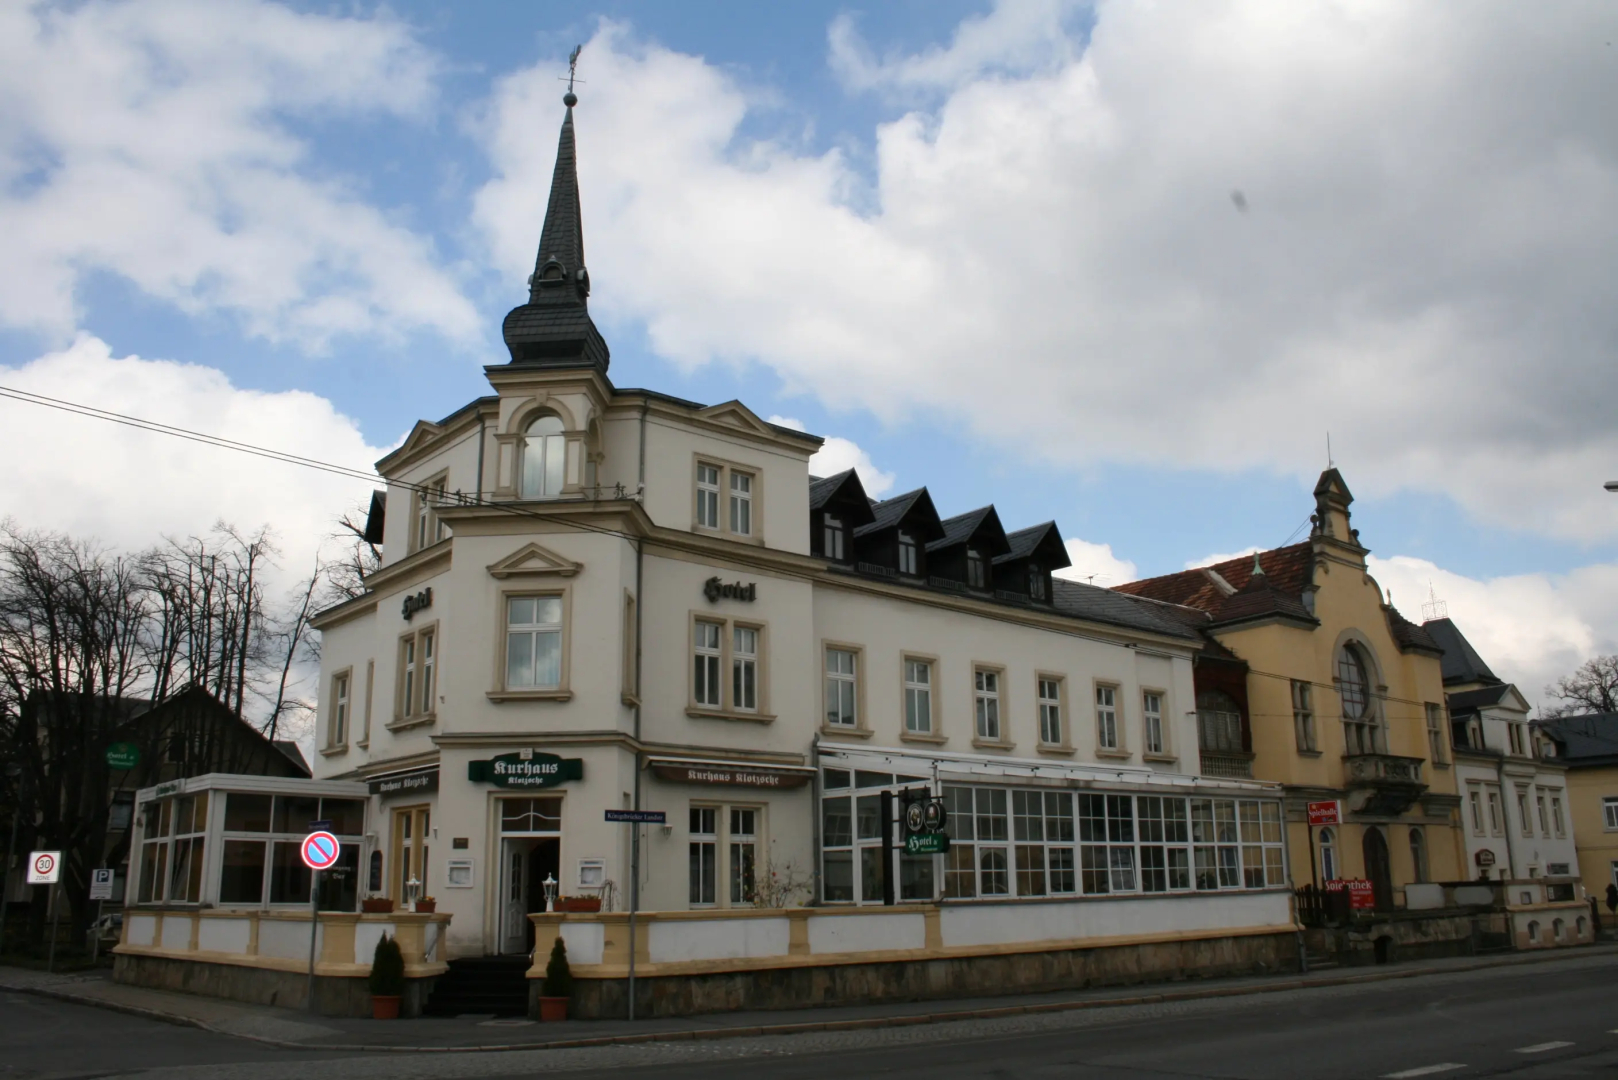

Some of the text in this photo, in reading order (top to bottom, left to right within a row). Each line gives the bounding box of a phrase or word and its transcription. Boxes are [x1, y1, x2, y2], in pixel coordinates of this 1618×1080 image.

[704, 576, 757, 602] Hotel
[401, 587, 432, 620] Hotel
[494, 760, 558, 777] Kurhaus
[507, 776, 544, 786] Klotzsche
[688, 769, 779, 786] Kurhaus Klotzsche
[908, 836, 932, 852] Hotel
[39, 860, 51, 869] 30
[1325, 881, 1372, 893] Spieothek
